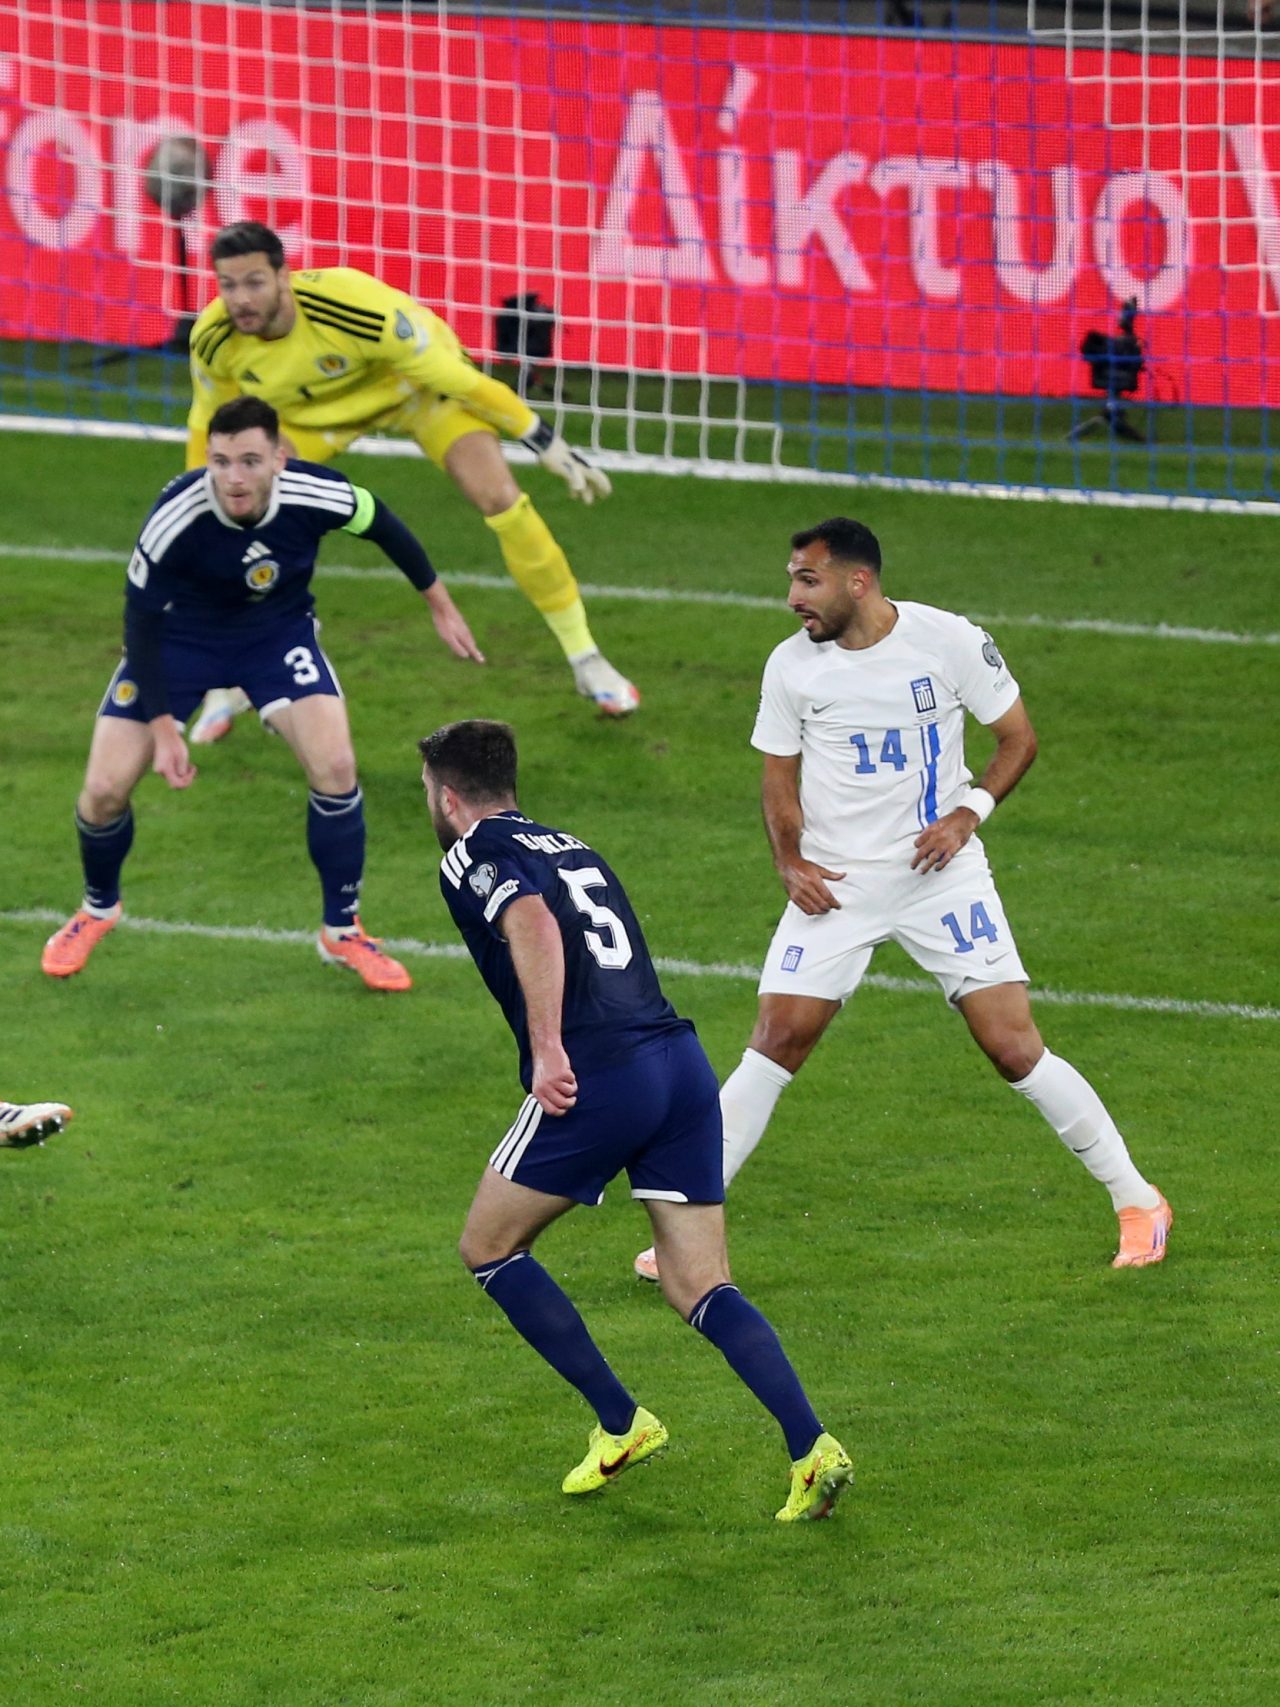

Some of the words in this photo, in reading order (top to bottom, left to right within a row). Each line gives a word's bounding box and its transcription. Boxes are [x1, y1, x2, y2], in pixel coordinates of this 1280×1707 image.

[592, 64, 1194, 313] Δίκτυο
[284, 646, 320, 685] 3
[849, 729, 908, 774] 14
[557, 867, 633, 970] 5
[940, 901, 998, 953] 14
